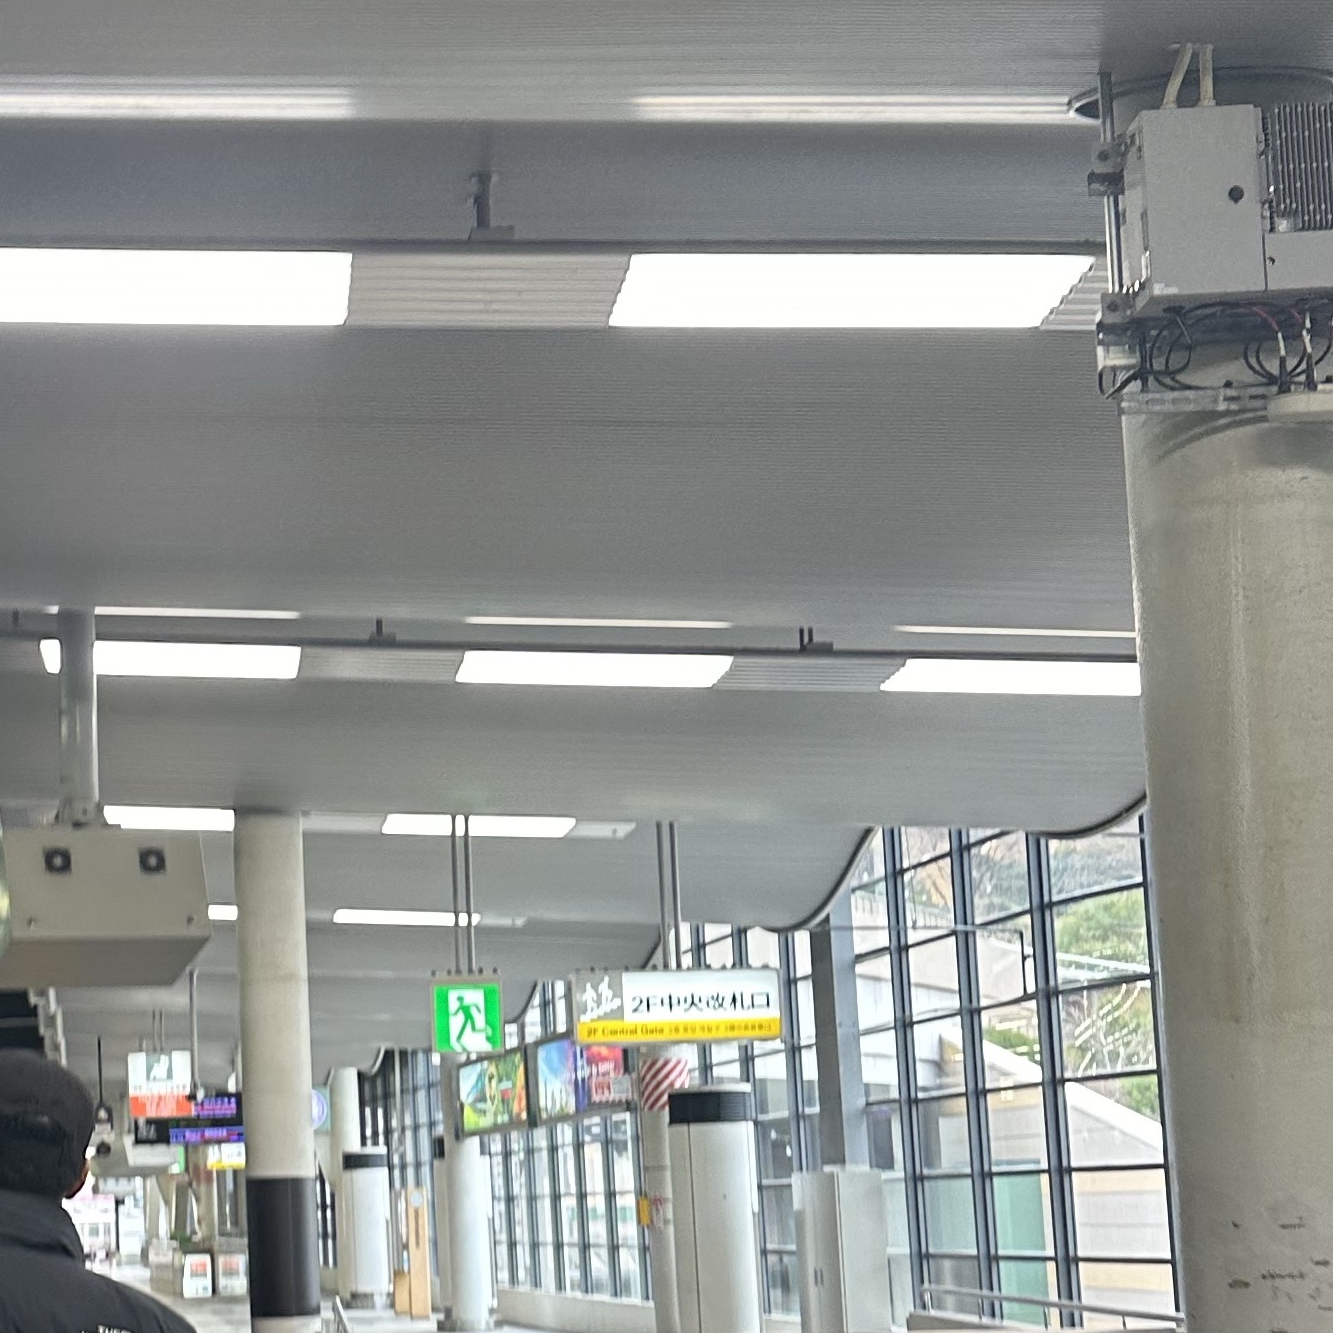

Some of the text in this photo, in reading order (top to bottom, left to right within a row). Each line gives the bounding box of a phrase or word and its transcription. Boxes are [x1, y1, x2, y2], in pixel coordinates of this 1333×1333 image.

[631, 991, 770, 1013] 2F中央改札口
[601, 1024, 637, 1036] Central
[641, 1023, 665, 1036] Gate
